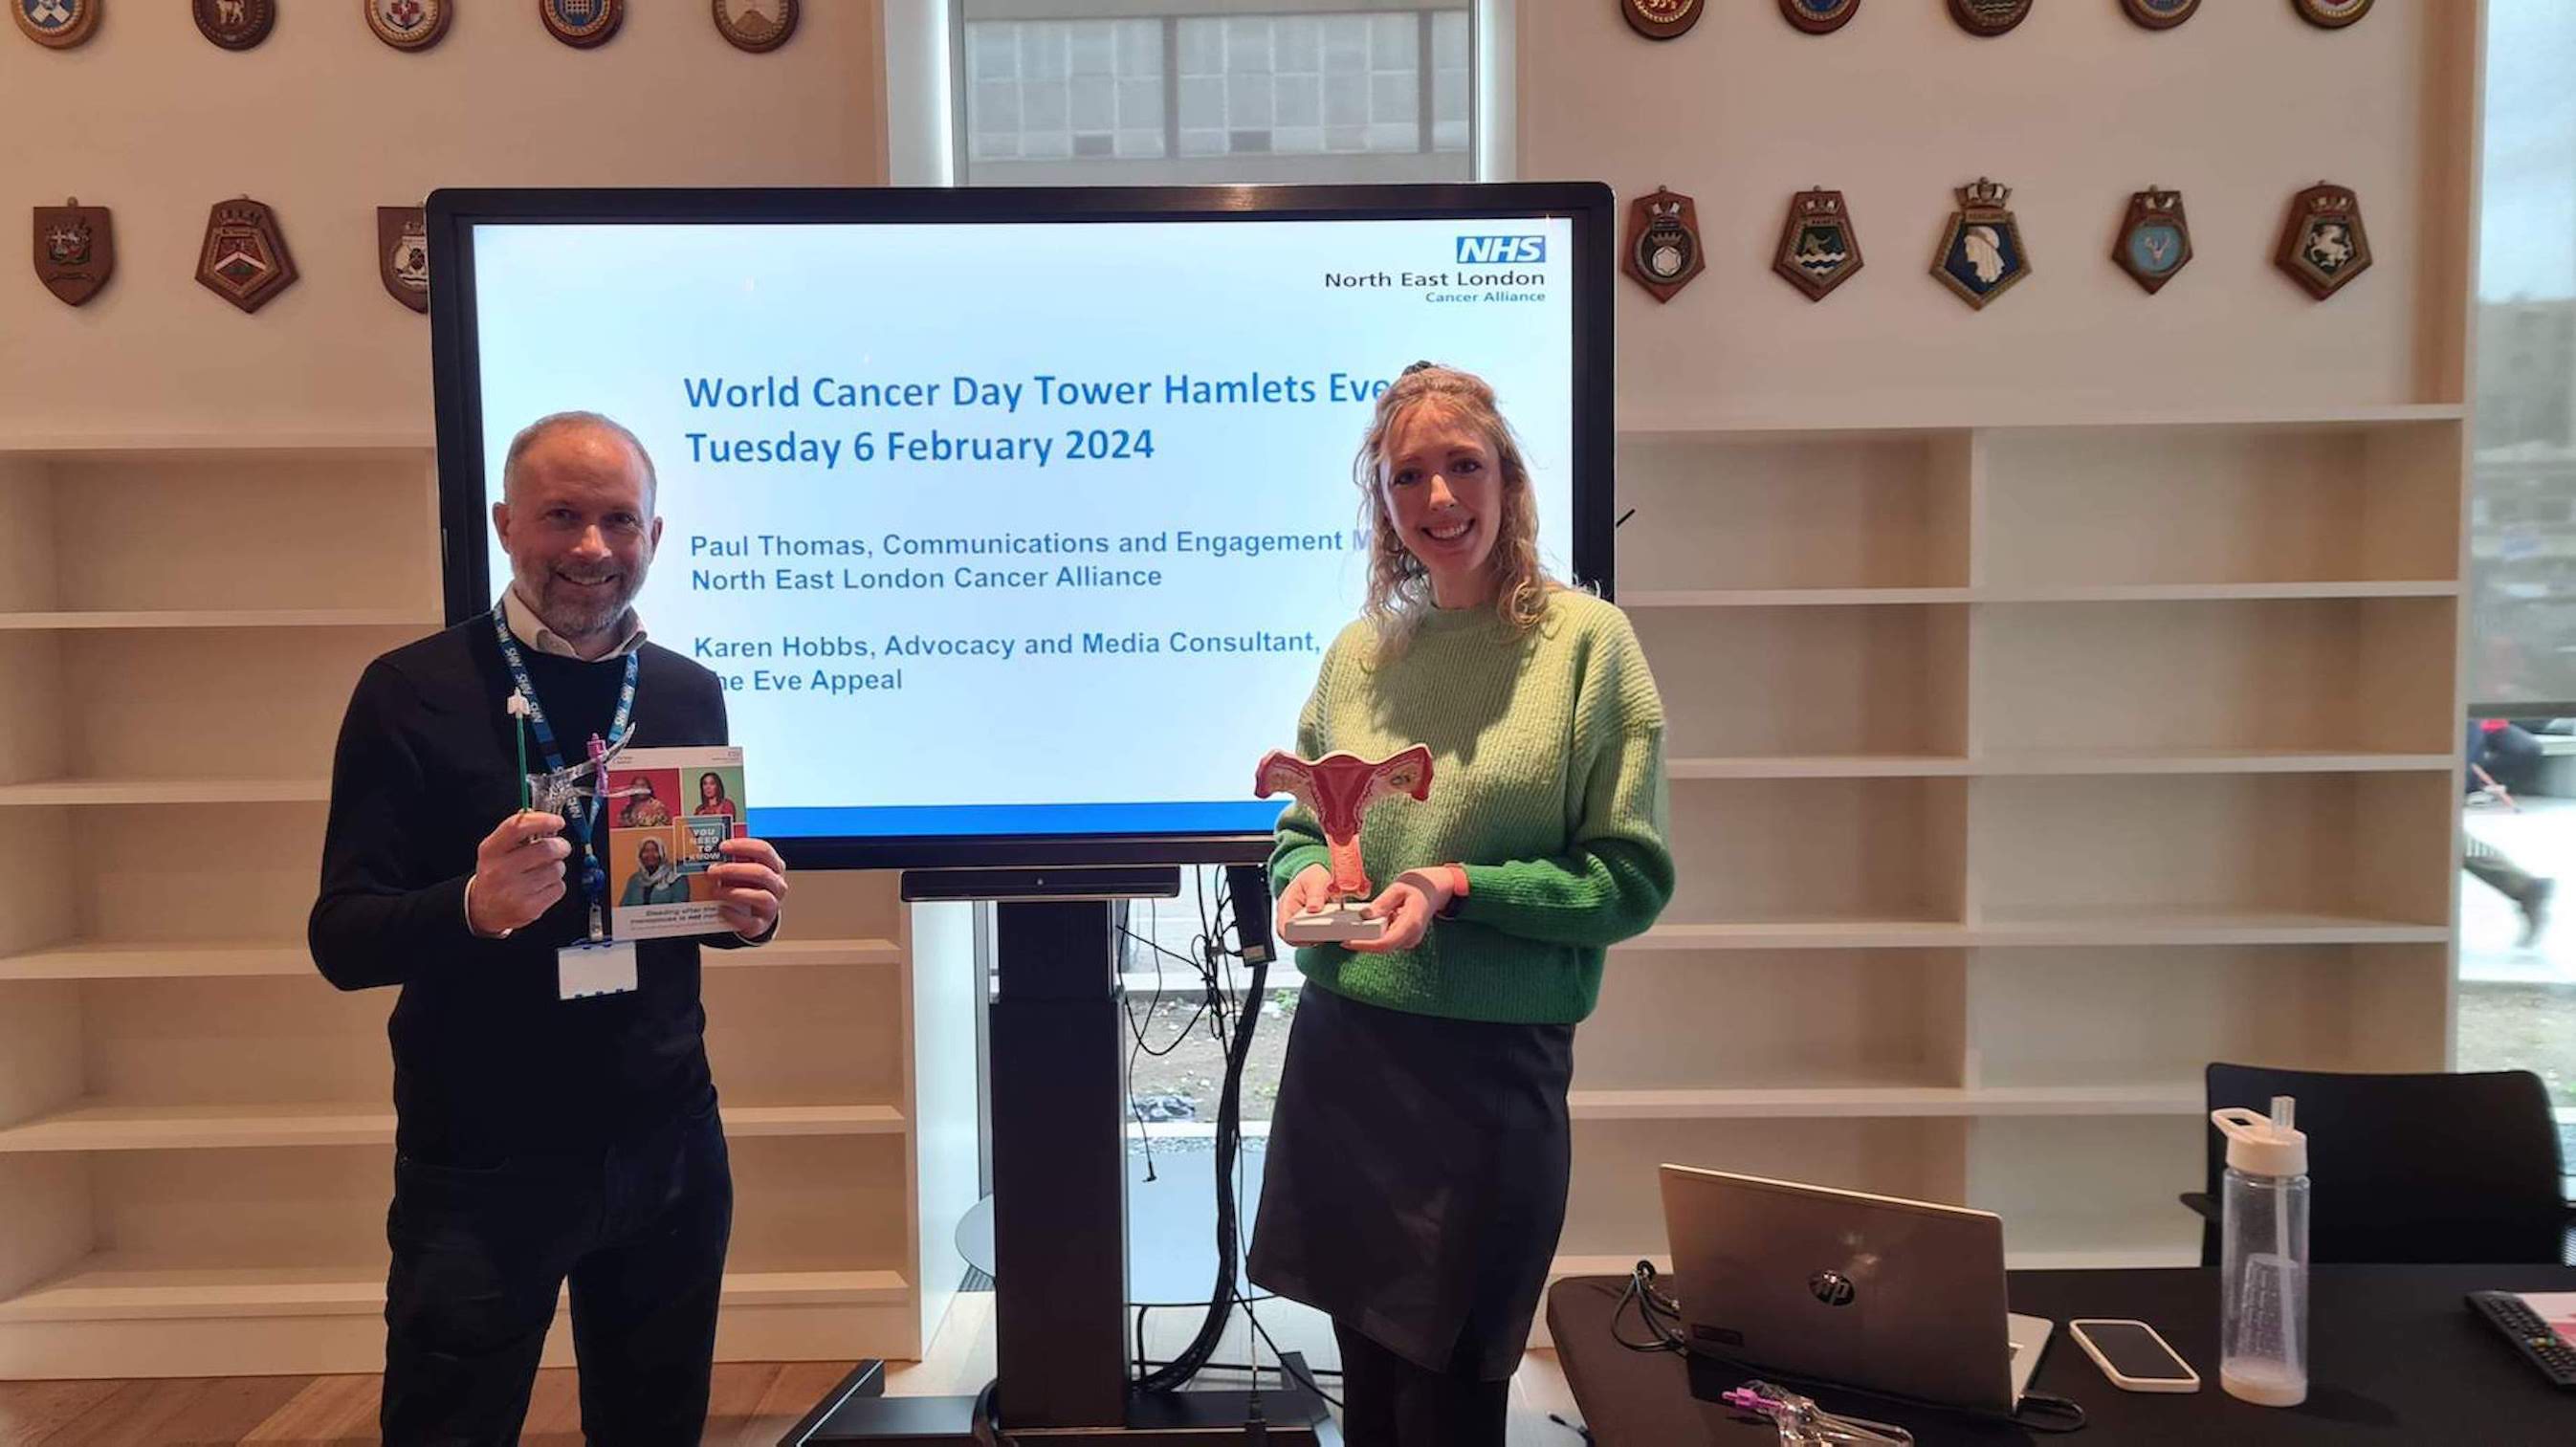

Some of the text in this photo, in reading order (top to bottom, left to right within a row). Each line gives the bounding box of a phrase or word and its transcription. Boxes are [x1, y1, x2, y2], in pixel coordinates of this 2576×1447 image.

[1458, 237, 1544, 263] NHS
[1325, 270, 1545, 288] North East London
[1425, 291, 1546, 303] Cancer Alliance
[684, 371, 1390, 413] World Cancer Day Tower Hamlets Eve
[685, 428, 1155, 470] Tuesday 6 February 2024
[691, 536, 749, 557] Paul
[758, 536, 873, 560] Thomas,
[883, 533, 1110, 555] Communications
[1119, 531, 1167, 553] and
[1177, 531, 1343, 558] Engagement
[693, 566, 1161, 589] North East London Cancer Alliance
[504, 647, 523, 668] NHS
[695, 631, 1320, 660] Karen Hobbs, Advocacy and Media Consultant,
[754, 670, 802, 691] Eve
[810, 669, 902, 695] Appeal
[693, 828, 716, 837] YOU
[696, 844, 714, 853] TO
